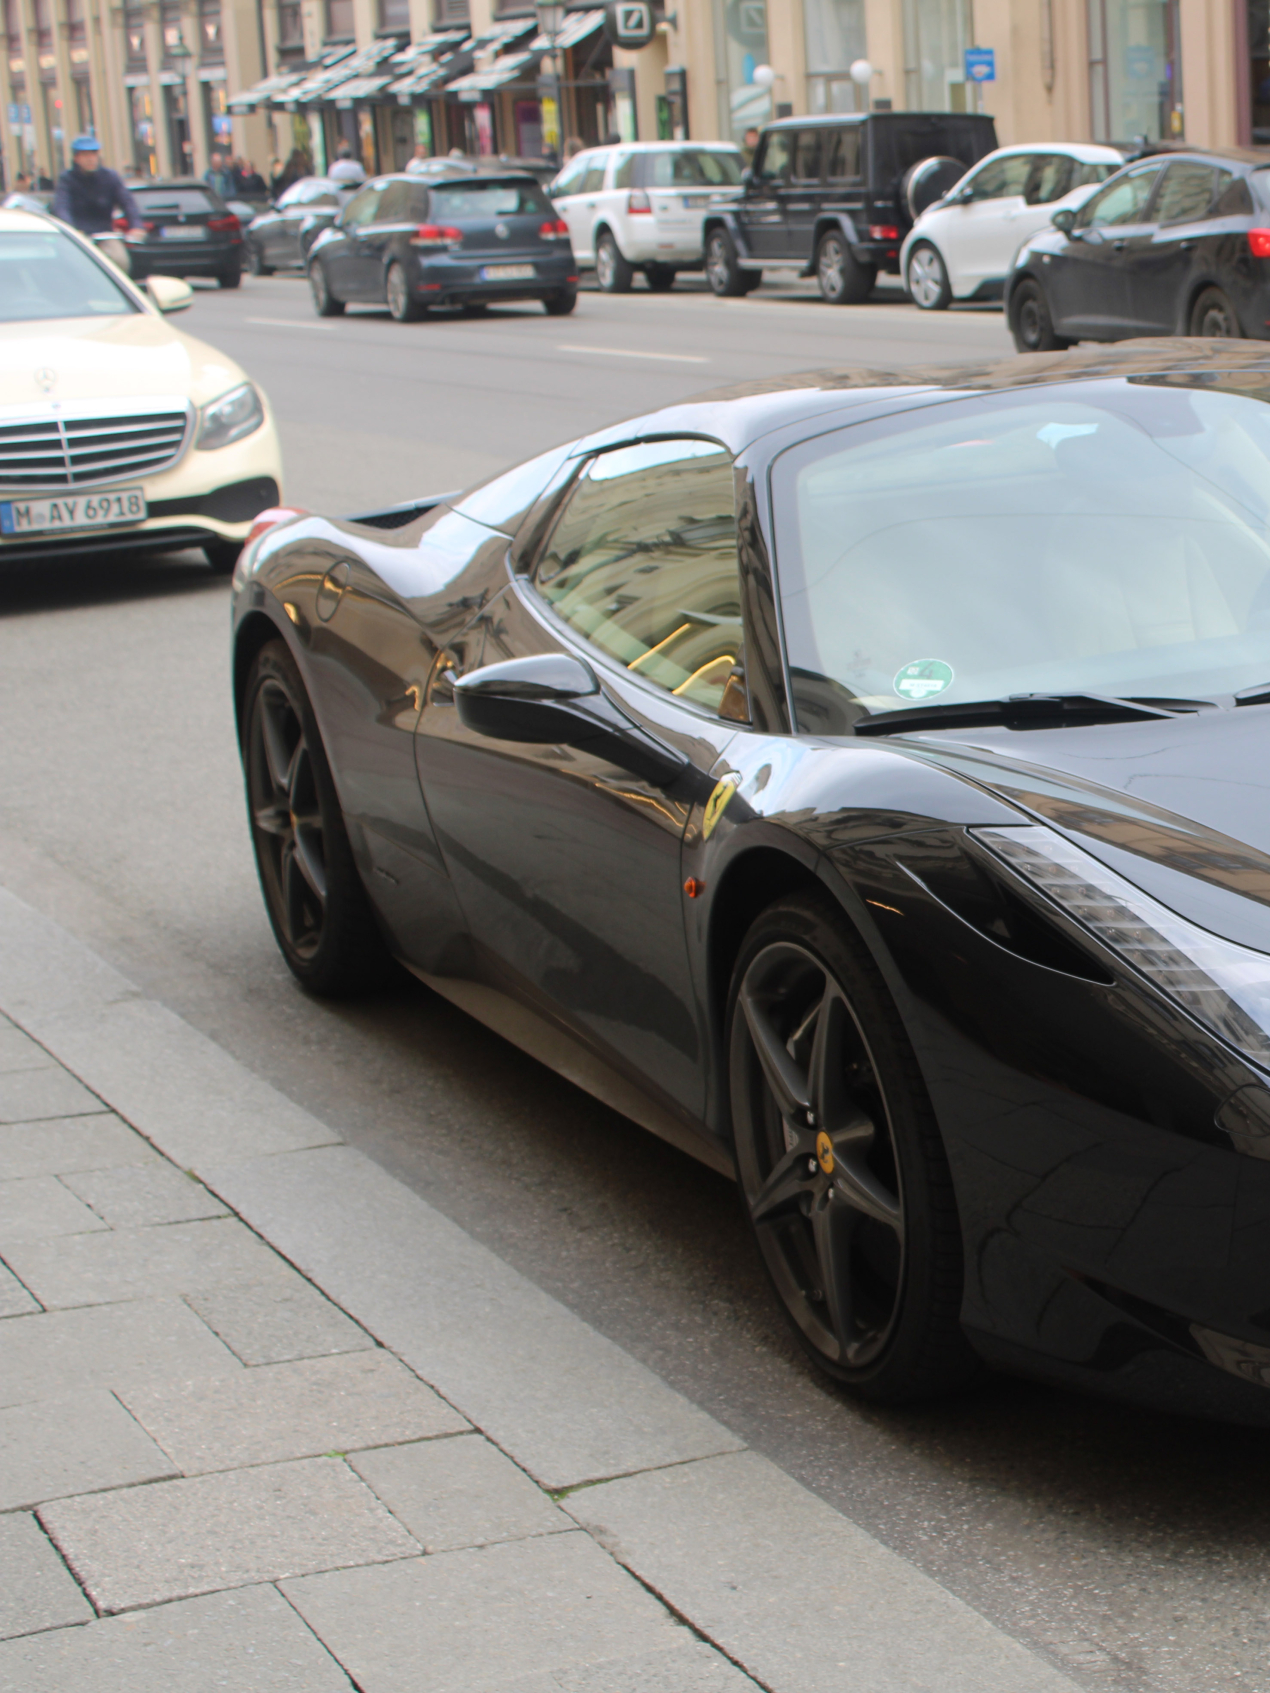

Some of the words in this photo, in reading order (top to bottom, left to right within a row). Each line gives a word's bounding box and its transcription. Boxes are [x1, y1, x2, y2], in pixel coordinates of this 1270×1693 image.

[14, 504, 32, 527] M
[49, 500, 78, 524] AY
[85, 494, 141, 519] 6918
